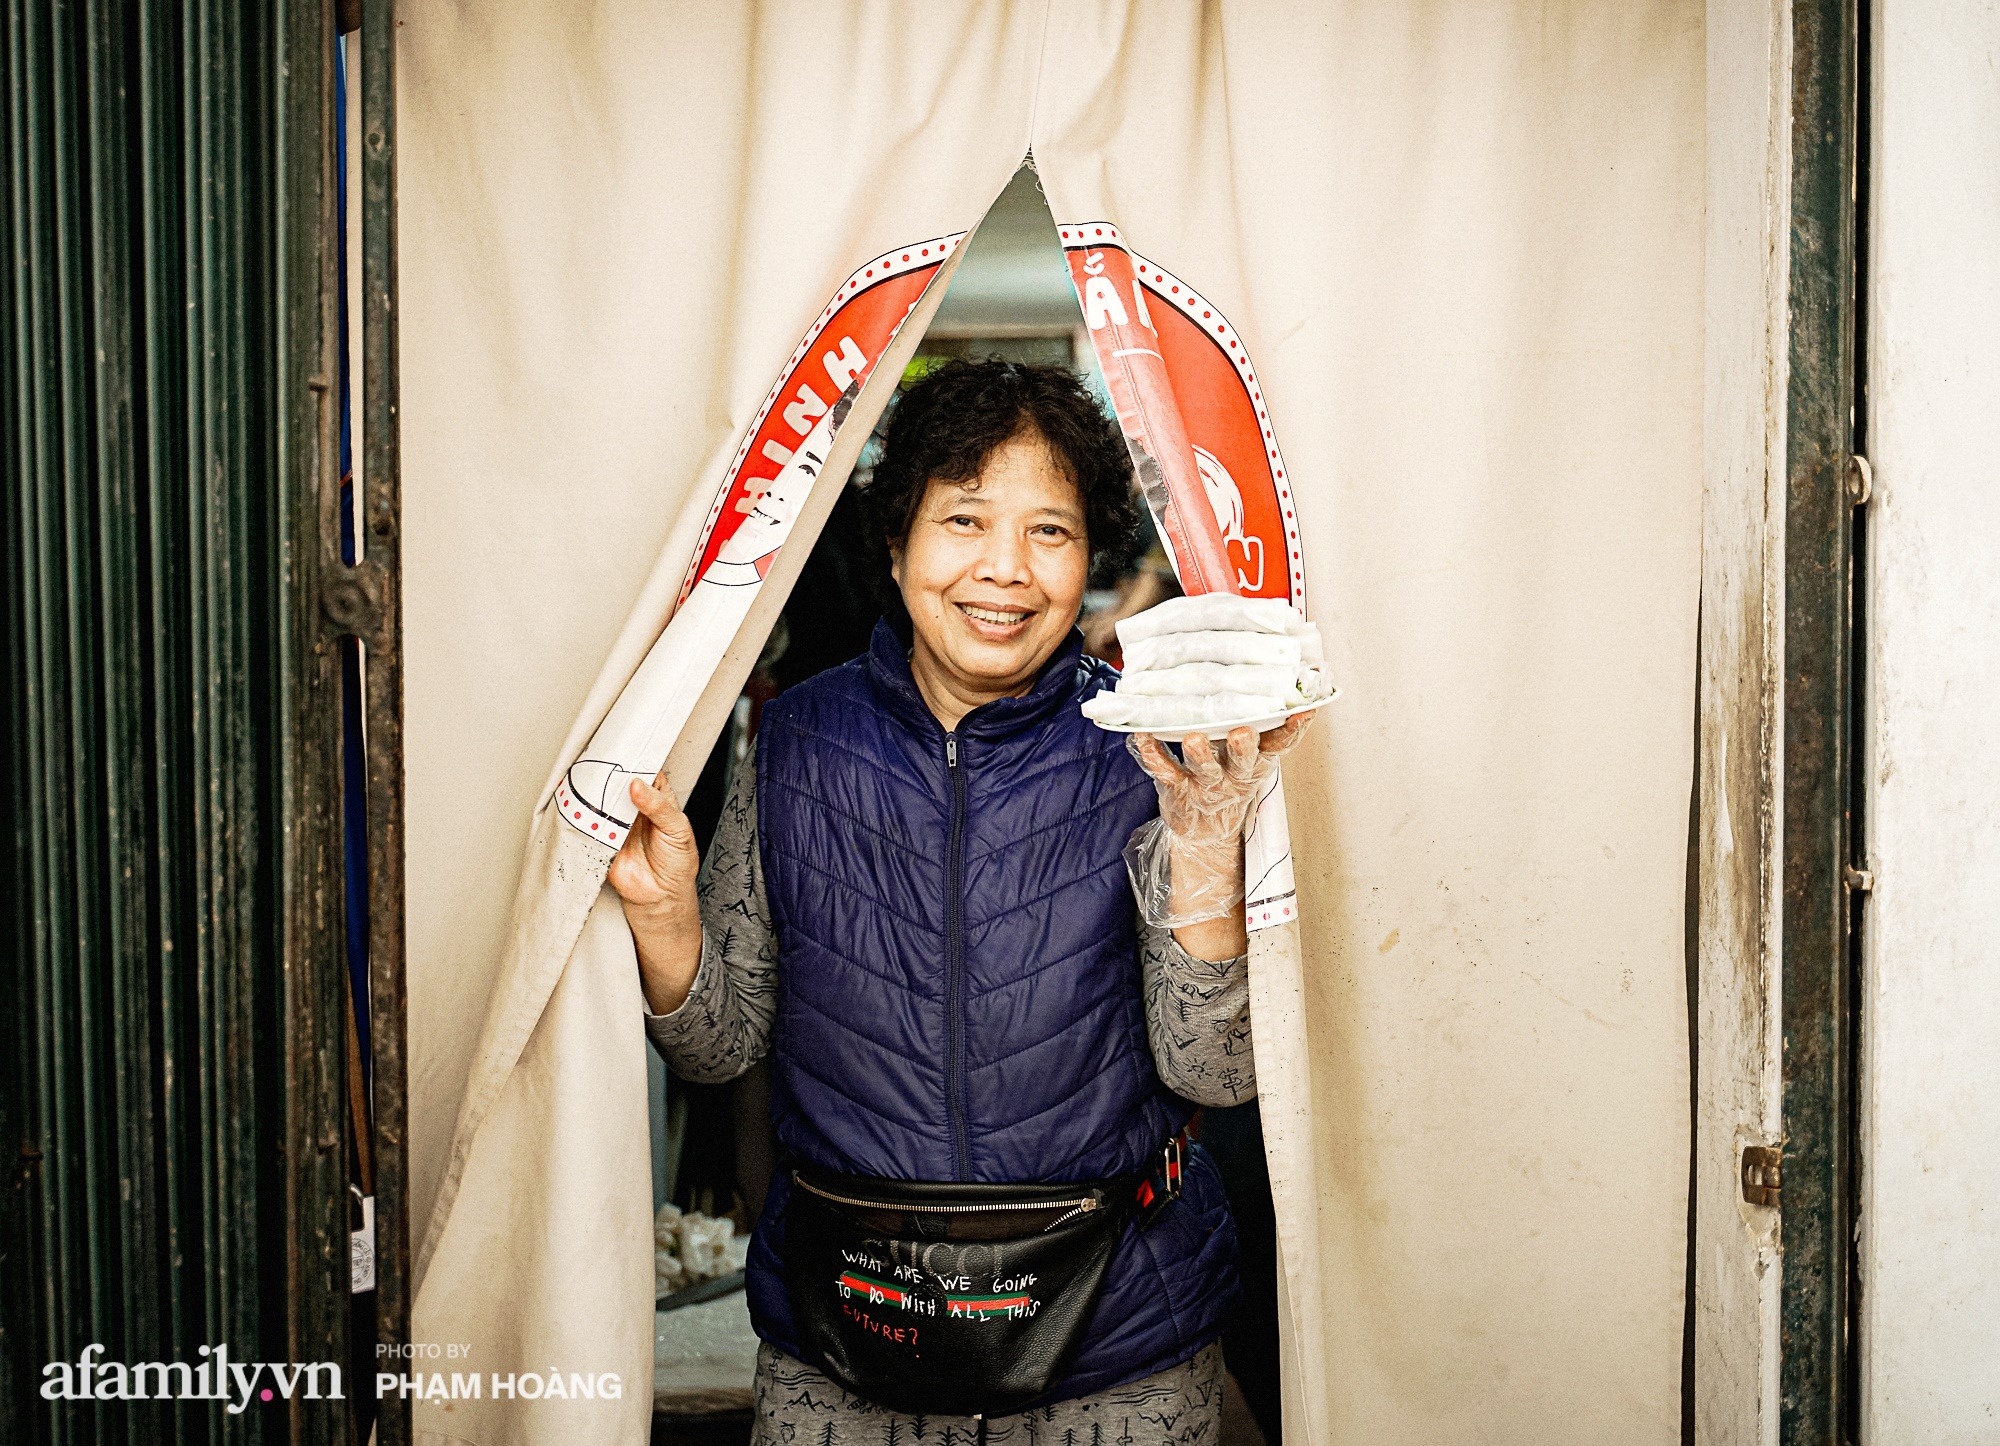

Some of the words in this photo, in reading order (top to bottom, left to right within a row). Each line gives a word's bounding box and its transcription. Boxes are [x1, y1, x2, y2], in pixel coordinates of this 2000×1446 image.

[842, 1249, 882, 1273] WHAT
[894, 1264, 923, 1284] ARE
[937, 1275, 971, 1291] WE
[835, 1281, 851, 1299] TO
[869, 1286, 885, 1305] DO
[951, 1305, 990, 1322] ALL
